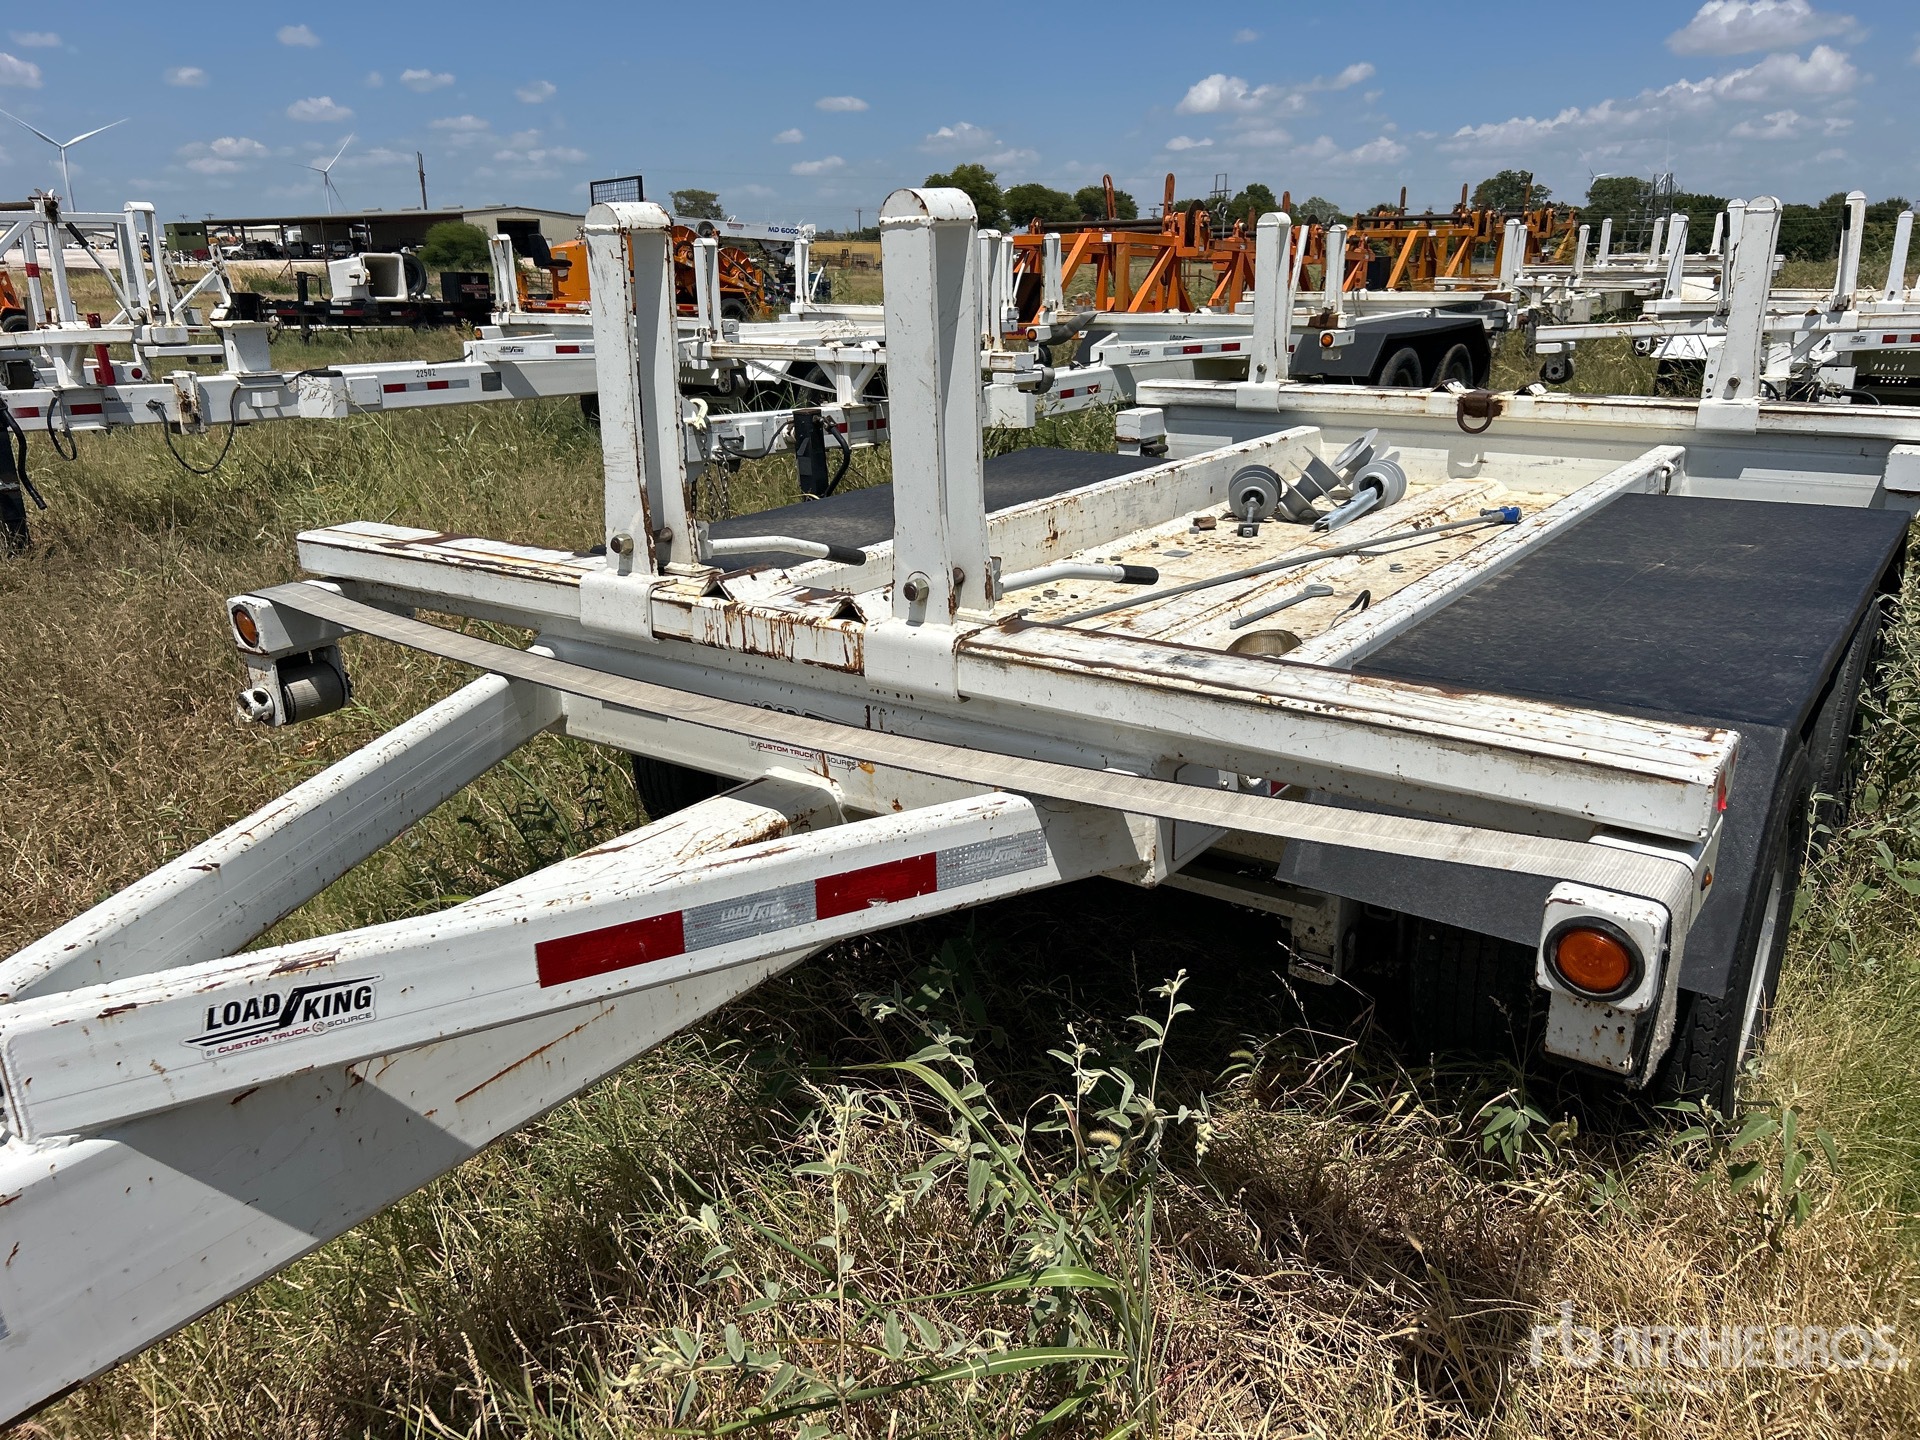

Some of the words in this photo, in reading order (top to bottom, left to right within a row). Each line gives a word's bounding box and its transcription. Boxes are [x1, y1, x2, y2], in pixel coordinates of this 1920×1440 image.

[780, 227, 800, 235] 6000
[415, 368, 437, 378] 22502
[758, 742, 789, 754] CUSTOM
[790, 749, 815, 759] TRUCK
[720, 904, 751, 921] LOAD
[206, 993, 280, 1031] LOAD
[302, 986, 372, 1023] KING
[218, 1037, 269, 1054] CUSTOM
[272, 1027, 310, 1040] TRUCK
[327, 1012, 373, 1028] SOURCE
